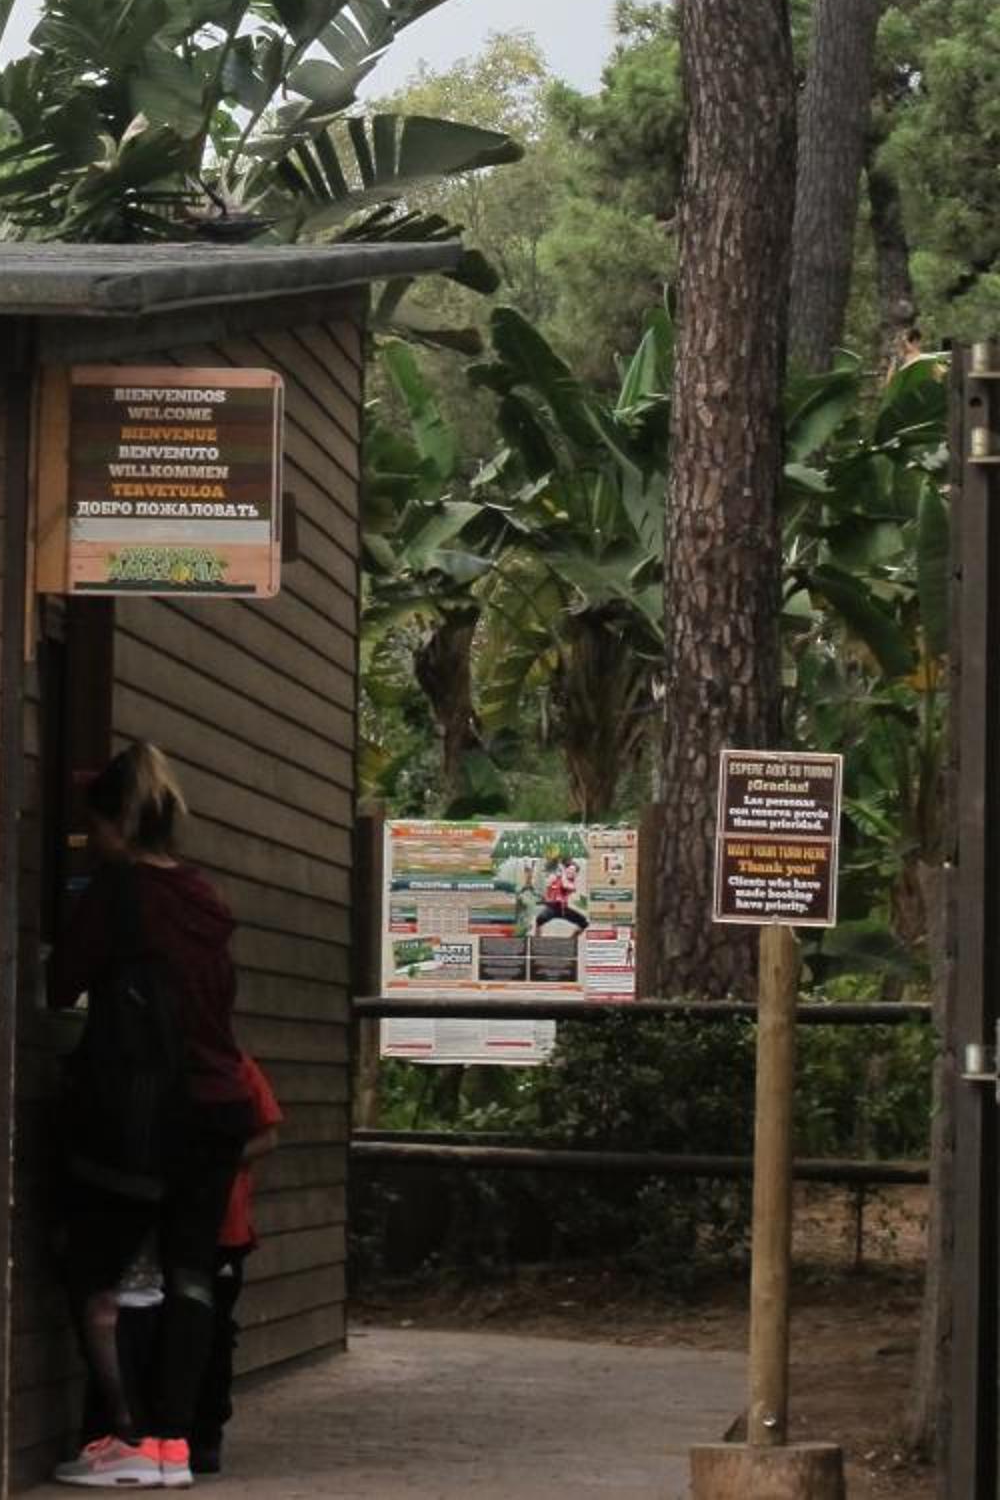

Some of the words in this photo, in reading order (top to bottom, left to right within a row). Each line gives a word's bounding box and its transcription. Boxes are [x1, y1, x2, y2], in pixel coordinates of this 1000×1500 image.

[114, 387, 226, 403] BIENVENIDOS
[128, 407, 213, 421] WELCOME
[121, 426, 217, 442] BIENVENUE
[119, 446, 219, 460] BENVENUTO
[108, 464, 229, 480] WILLKOMMEN
[111, 483, 226, 498] TERVETULOA
[77, 502, 132, 517] ДОБРО
[135, 502, 259, 518] ПОЖАЛОВАТЬ
[729, 762, 764, 775] ESPERE
[743, 795, 764, 805] Las
[765, 798, 815, 807] personas
[729, 807, 749, 815] con
[752, 808, 792, 817] reserva
[794, 809, 829, 819] previa
[733, 816, 768, 827] tienen
[738, 860, 783, 873] Thank
[786, 863, 816, 876] you!
[728, 876, 766, 886] Clients
[767, 877, 792, 888] who
[793, 878, 821, 889] have
[735, 887, 766, 898] made
[767, 888, 813, 902] booking
[735, 898, 763, 908] have
[765, 900, 809, 913] priority.
